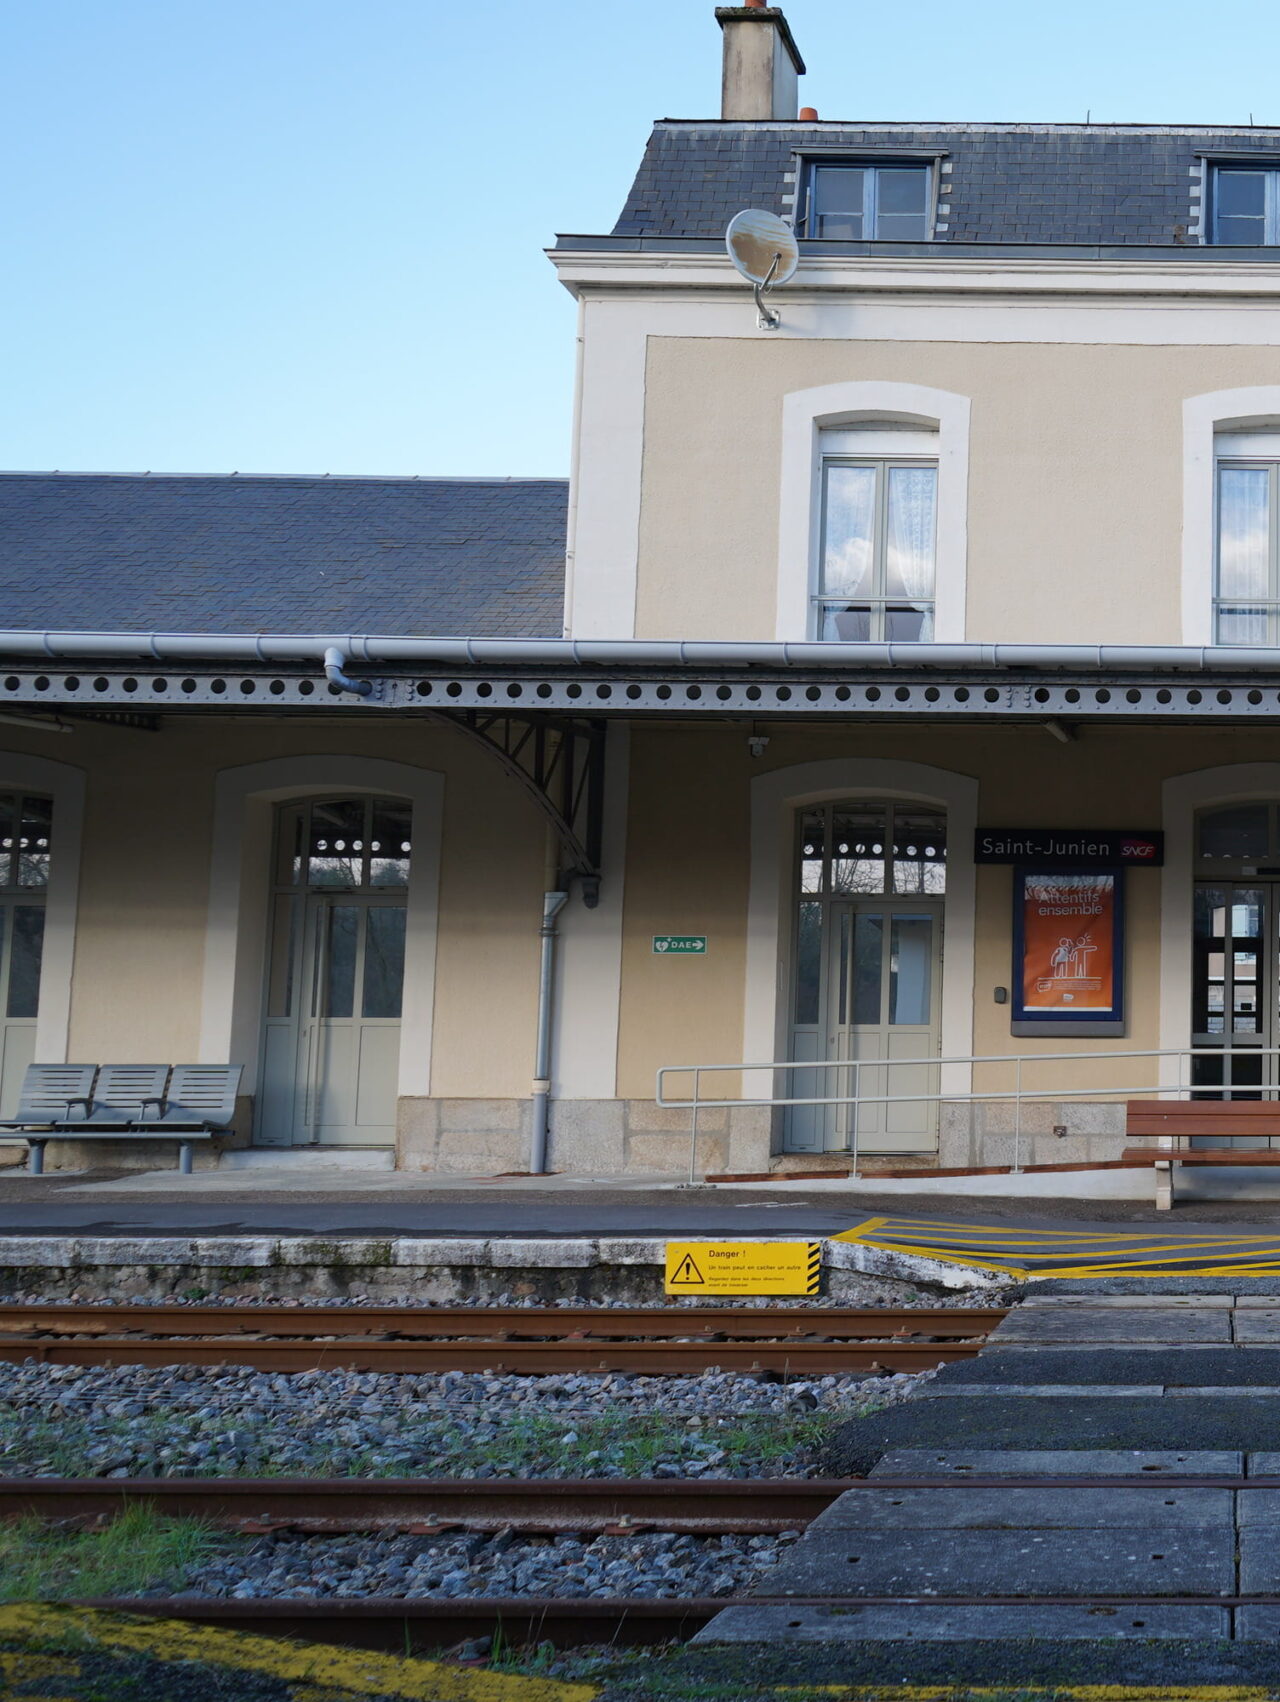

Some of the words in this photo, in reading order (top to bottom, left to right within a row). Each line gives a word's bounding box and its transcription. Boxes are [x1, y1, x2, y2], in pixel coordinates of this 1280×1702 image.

[982, 838, 1110, 856] Saint-Junien
[1121, 846, 1154, 856] SNCF
[1038, 890, 1100, 904] Attentifs
[1038, 903, 1103, 916] ensemble
[671, 941, 691, 949] DAE
[708, 1249, 740, 1259] Danger
